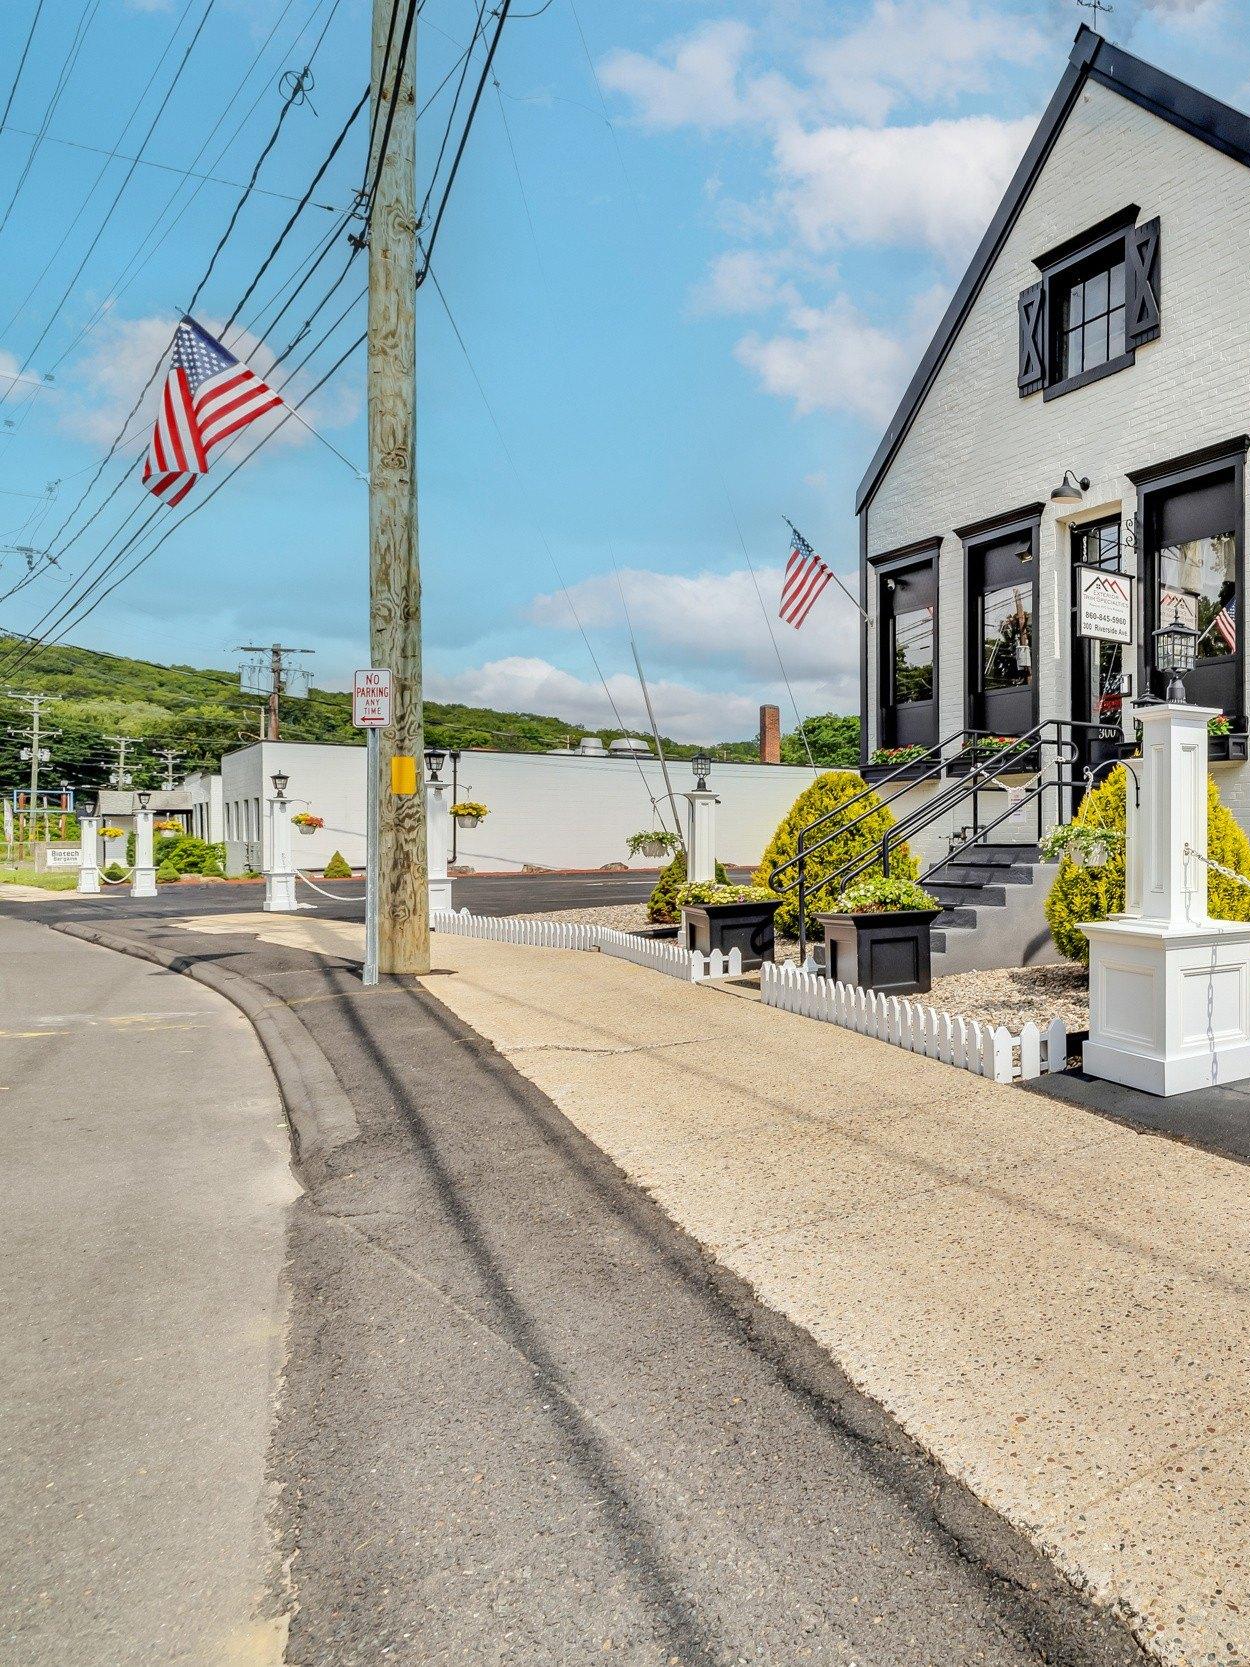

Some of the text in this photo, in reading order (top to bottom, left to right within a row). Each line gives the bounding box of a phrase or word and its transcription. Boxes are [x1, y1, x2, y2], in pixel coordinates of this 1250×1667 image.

[1083, 622, 1092, 631] 300
[1095, 624, 1118, 635] Riverside
[365, 674, 380, 685] NO
[356, 686, 389, 698] PARKING
[364, 707, 382, 715] TIME
[1098, 728, 1117, 739] 300
